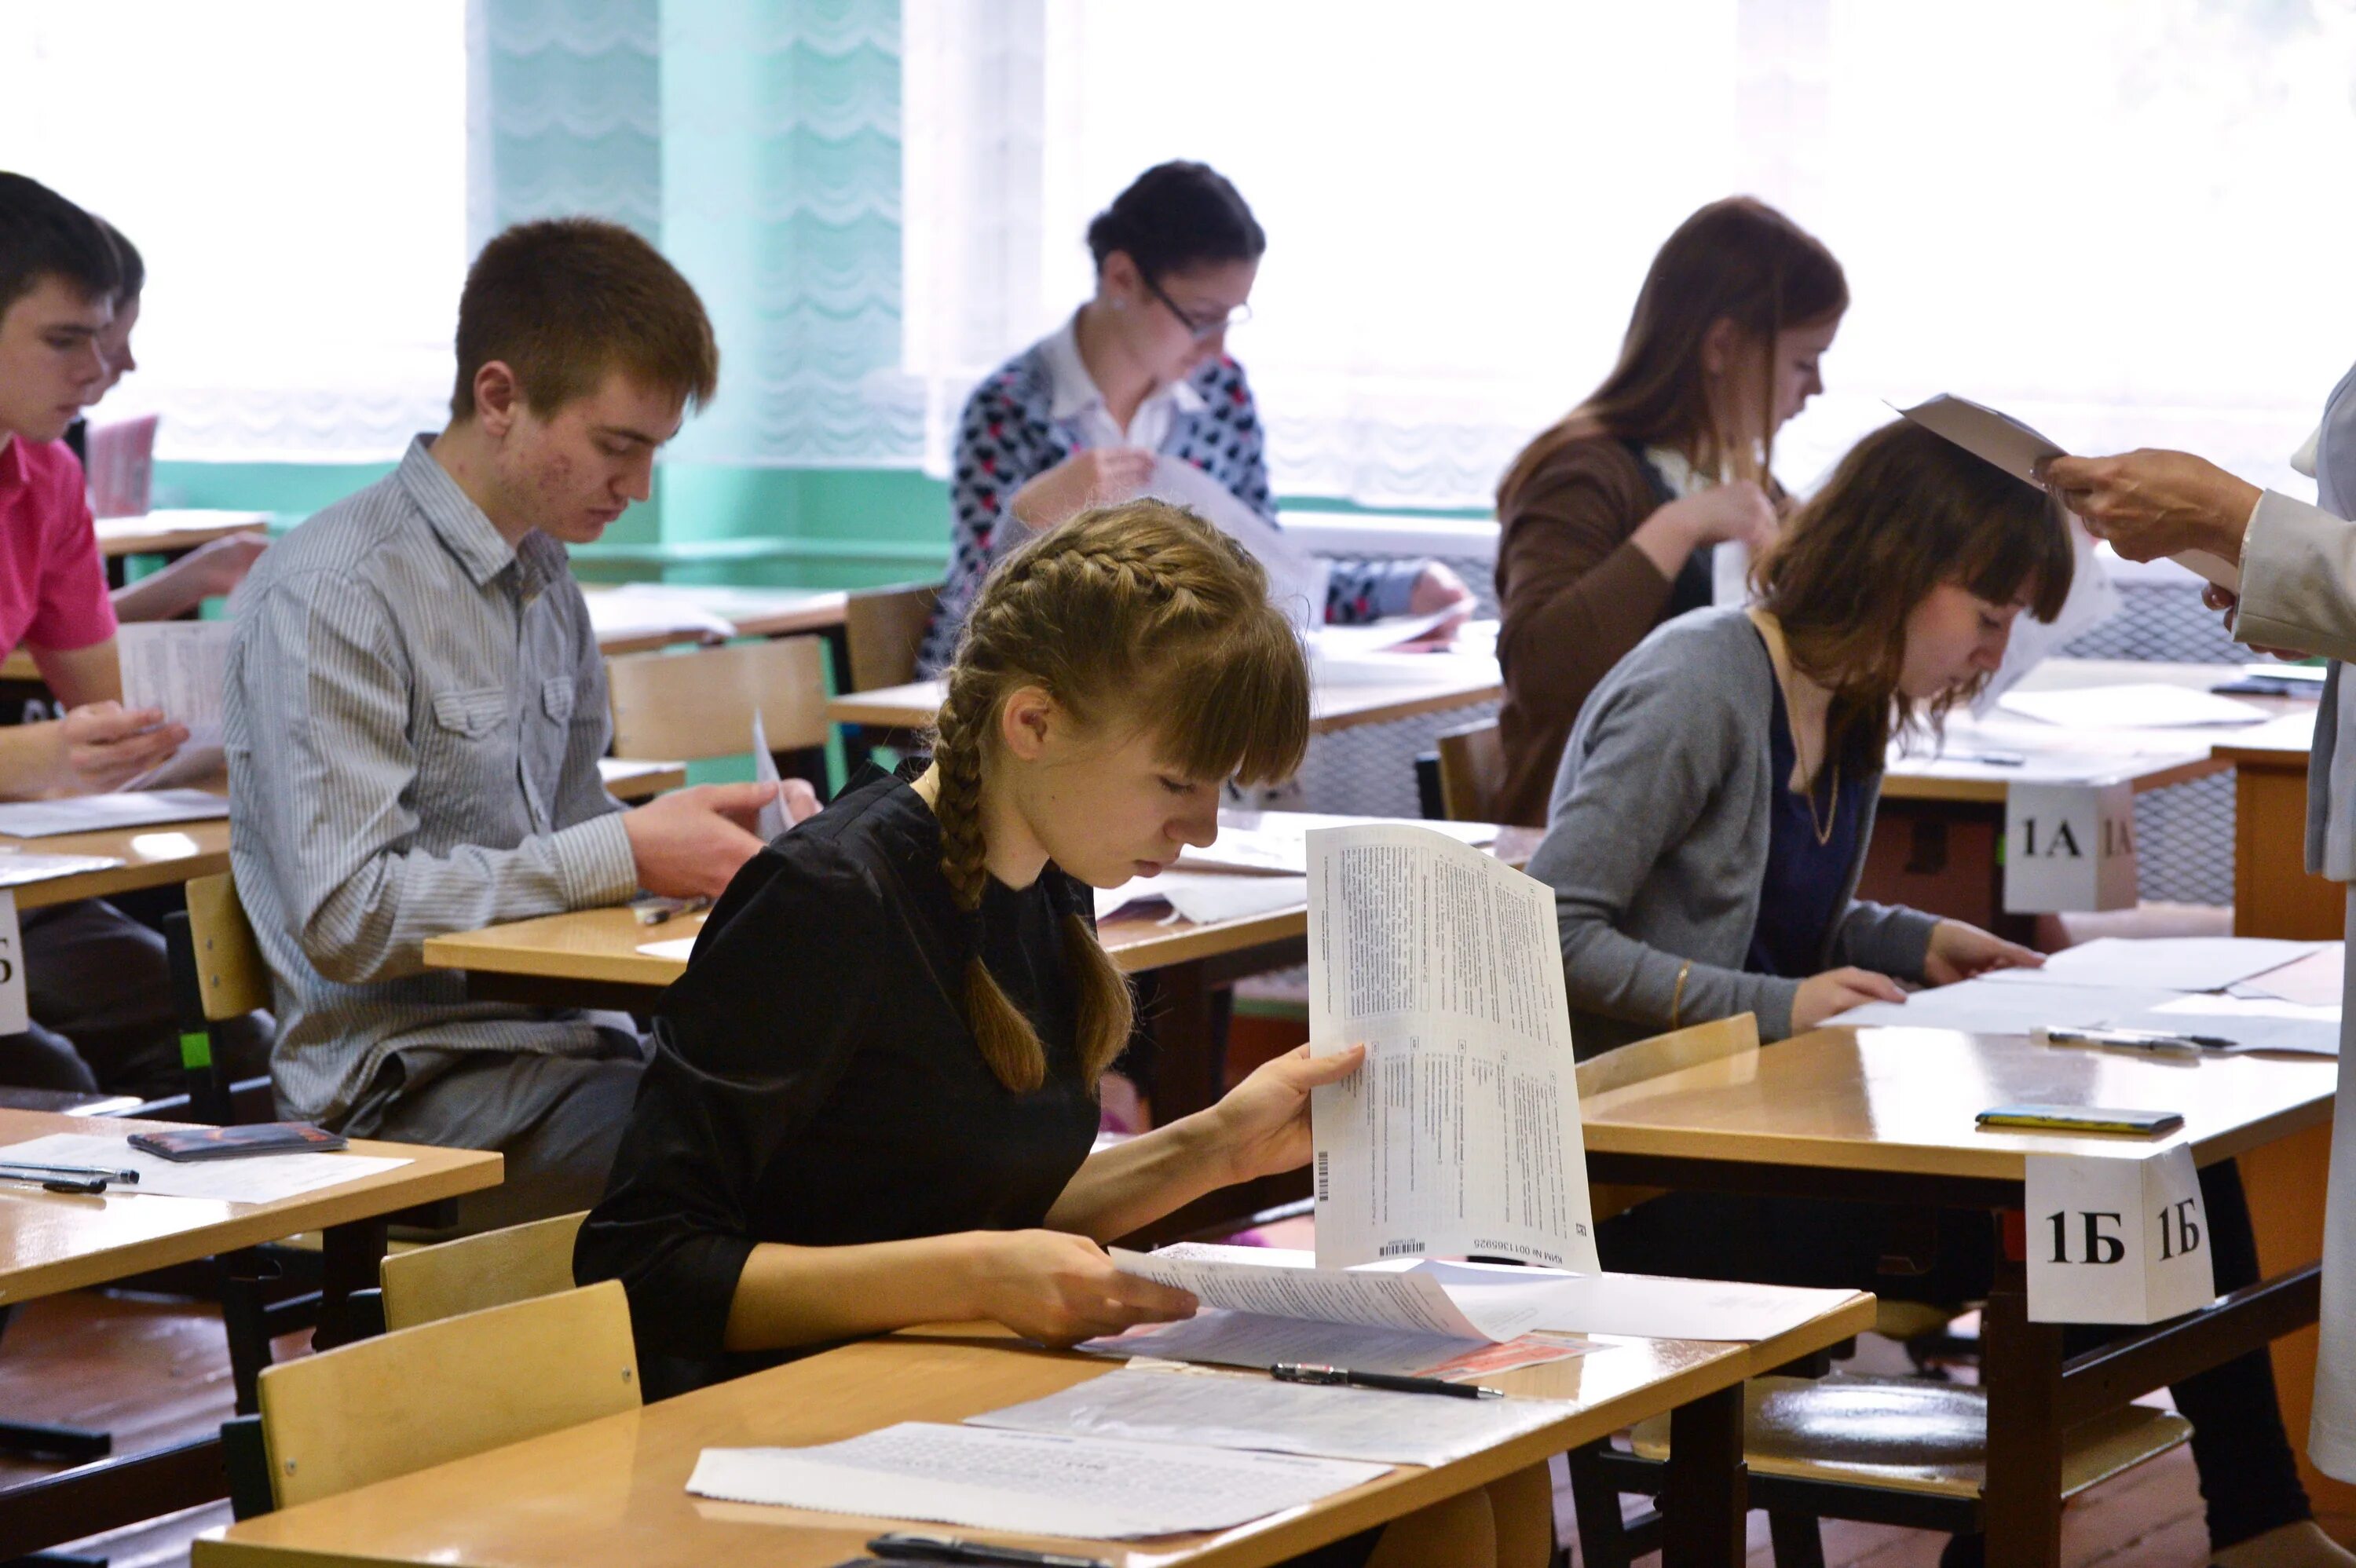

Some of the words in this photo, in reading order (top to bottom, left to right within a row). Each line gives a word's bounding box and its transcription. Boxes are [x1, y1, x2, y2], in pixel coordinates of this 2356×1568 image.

[2024, 818, 2083, 857] 1А
[2046, 1211, 2125, 1264] 1Б
[2158, 1197, 2200, 1262] 1Б
[1474, 1240, 1531, 1255] 0011365925
[1532, 1249, 1542, 1259] №
[1544, 1252, 1563, 1264] КИМ
